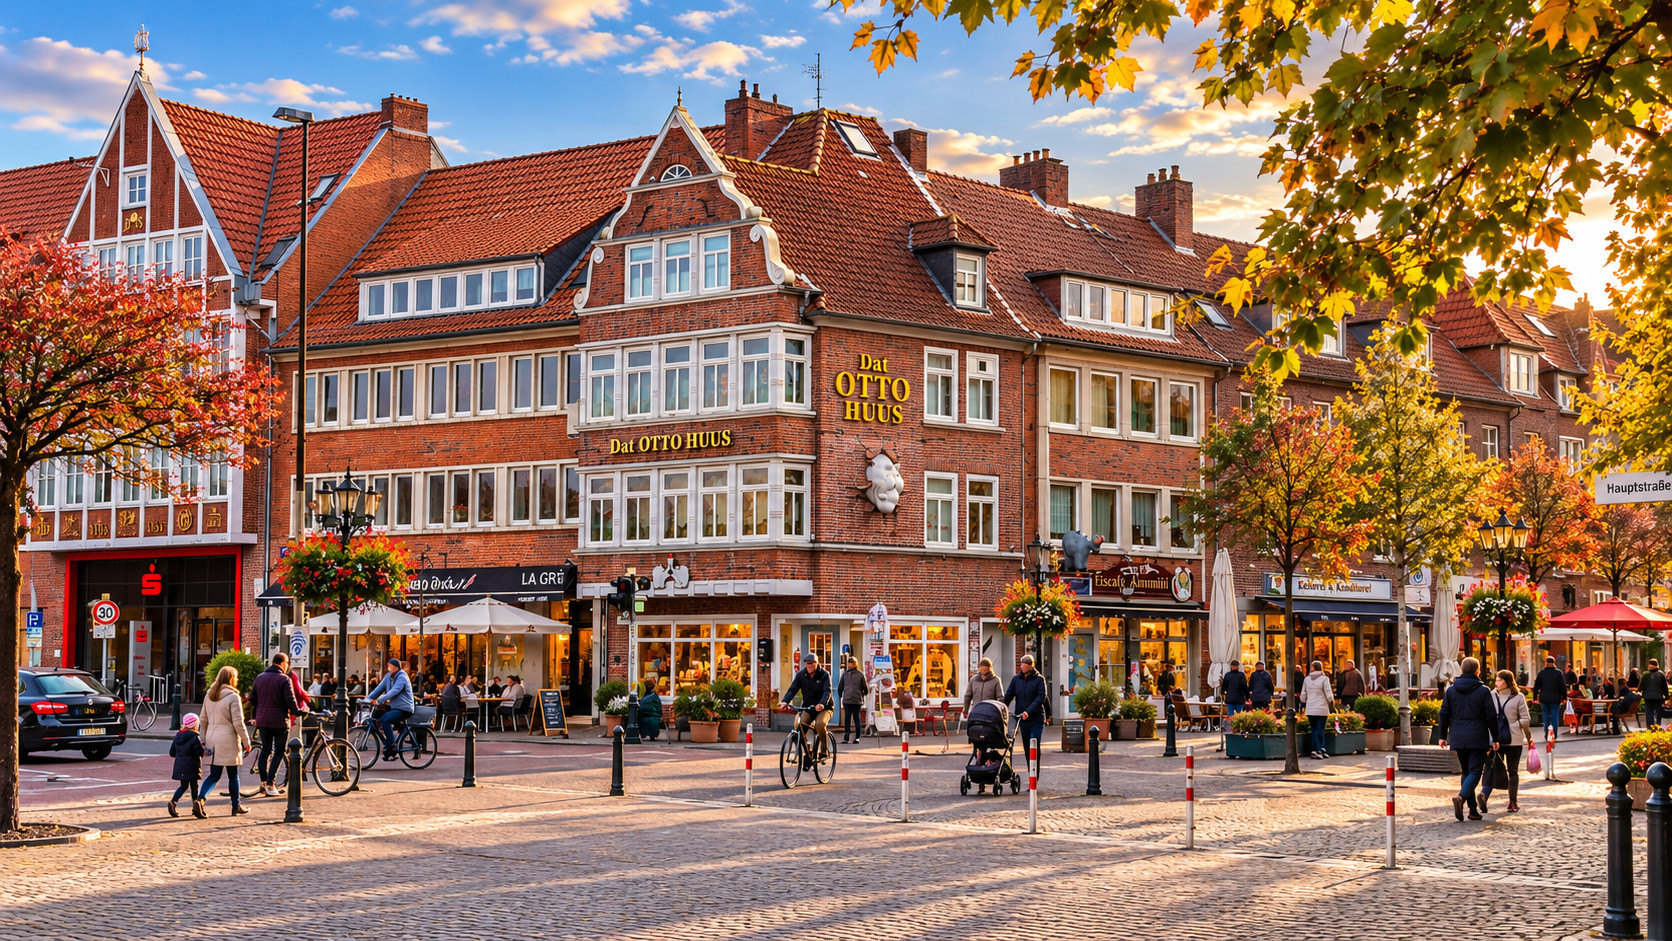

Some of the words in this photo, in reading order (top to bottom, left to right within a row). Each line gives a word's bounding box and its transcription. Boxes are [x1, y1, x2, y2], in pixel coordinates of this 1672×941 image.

[860, 353, 888, 372] Dat
[835, 371, 911, 402] OTTO
[844, 400, 904, 424] HUUS
[610, 438, 635, 454] Dat
[639, 434, 682, 452] OTTO
[686, 429, 732, 449] HUUS
[1607, 480, 1672, 495] Hauptstraße
[521, 572, 537, 586] LA
[98, 607, 114, 619] 30
